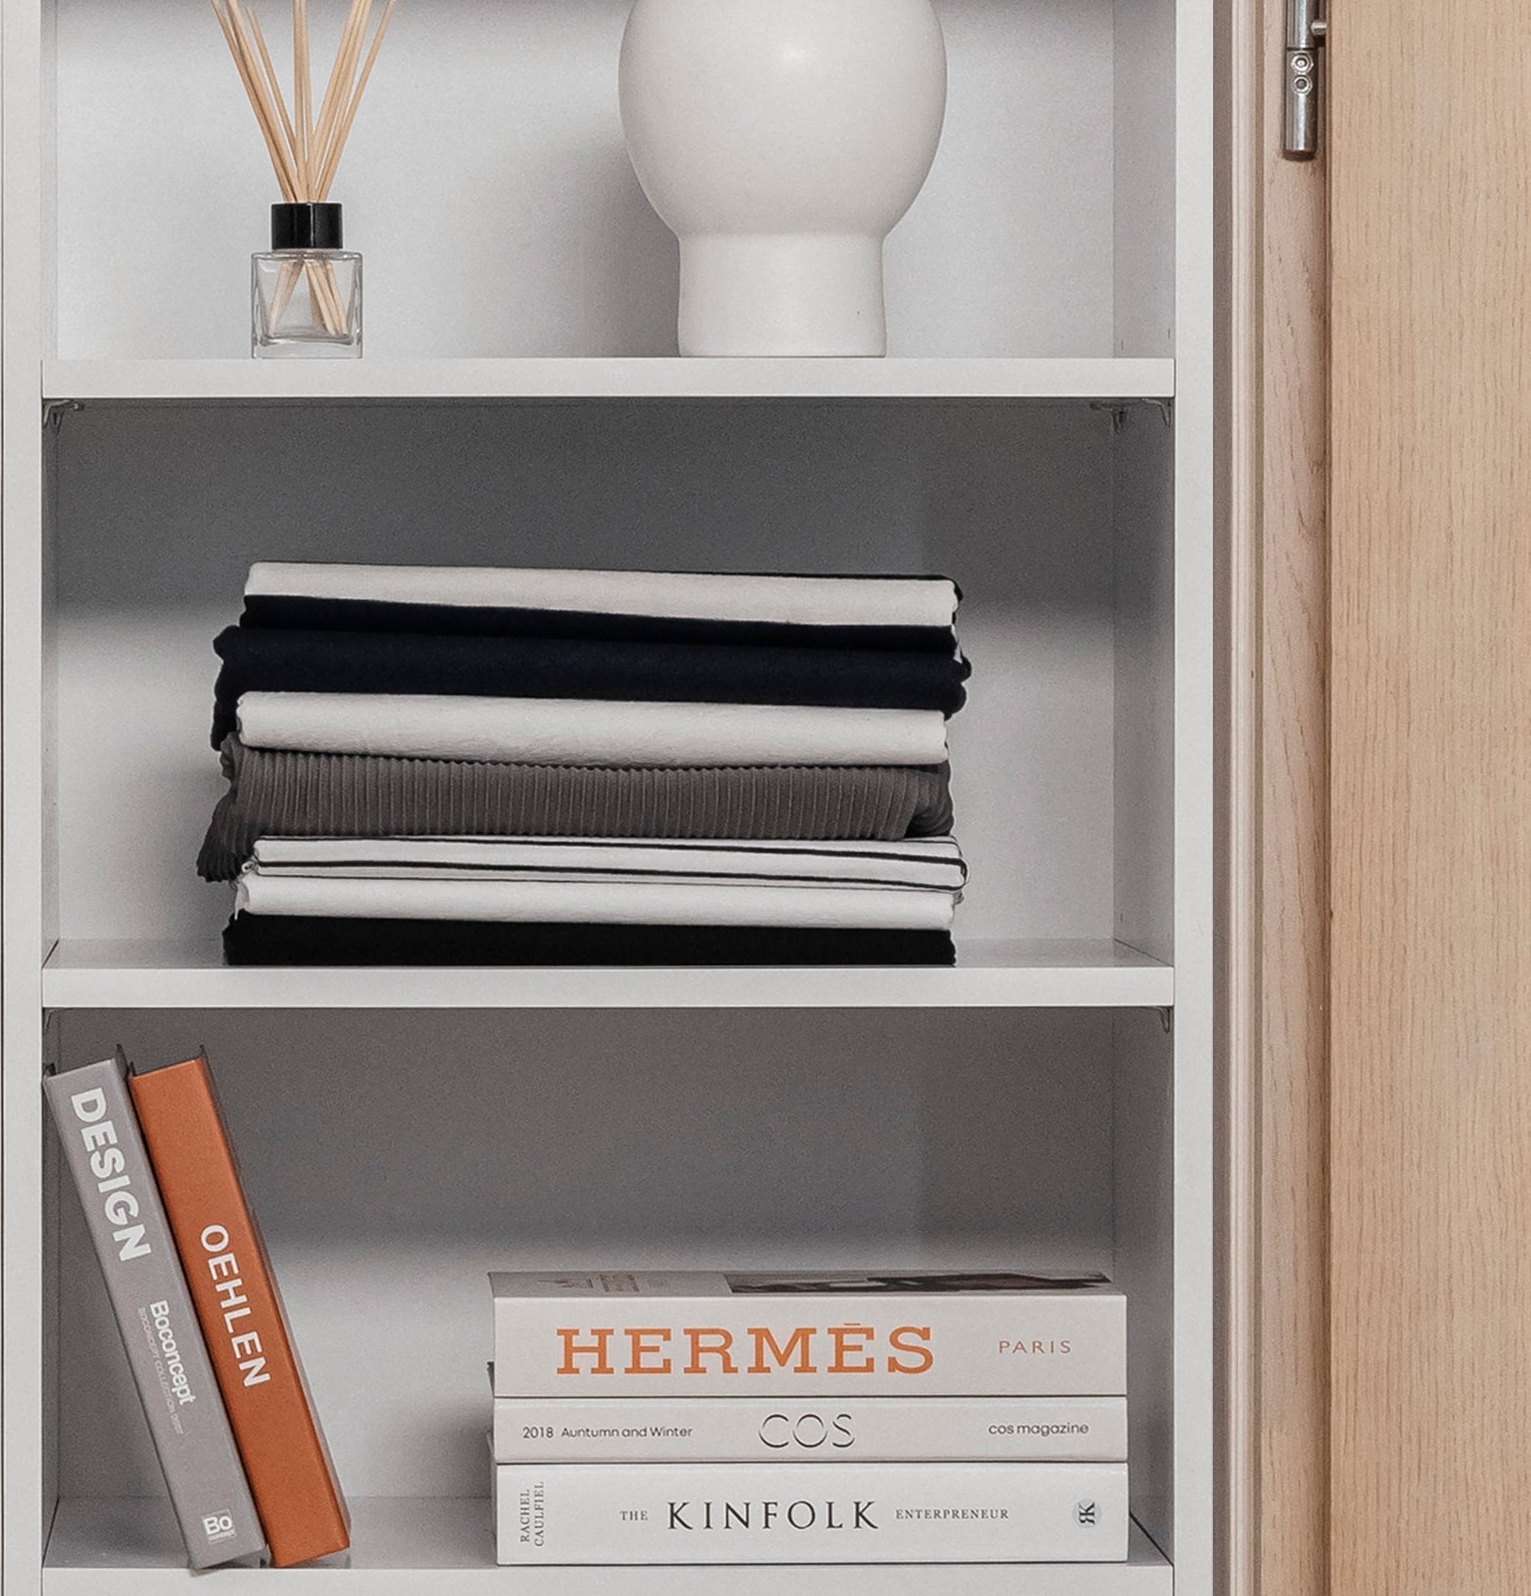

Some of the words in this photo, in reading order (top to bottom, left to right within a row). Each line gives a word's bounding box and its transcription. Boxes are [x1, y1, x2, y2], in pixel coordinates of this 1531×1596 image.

[71, 1087, 152, 1261] DESIGN
[200, 1224, 271, 1387] OEHLEN
[150, 1299, 196, 1405] Boconcept
[998, 1340, 1072, 1354] PARIS
[522, 1426, 554, 1439] 2018
[621, 1425, 647, 1438] and
[649, 1425, 693, 1438] Winter
[758, 1413, 856, 1449] COS
[988, 1423, 1015, 1435] cos
[1017, 1422, 1089, 1437] magazine
[519, 1489, 530, 1542] RACHEL
[534, 1481, 545, 1547] CAULFIEL
[620, 1510, 649, 1521] THE
[667, 1500, 879, 1531] KINFOLK
[895, 1509, 1010, 1520] ENTERPRENEUR
